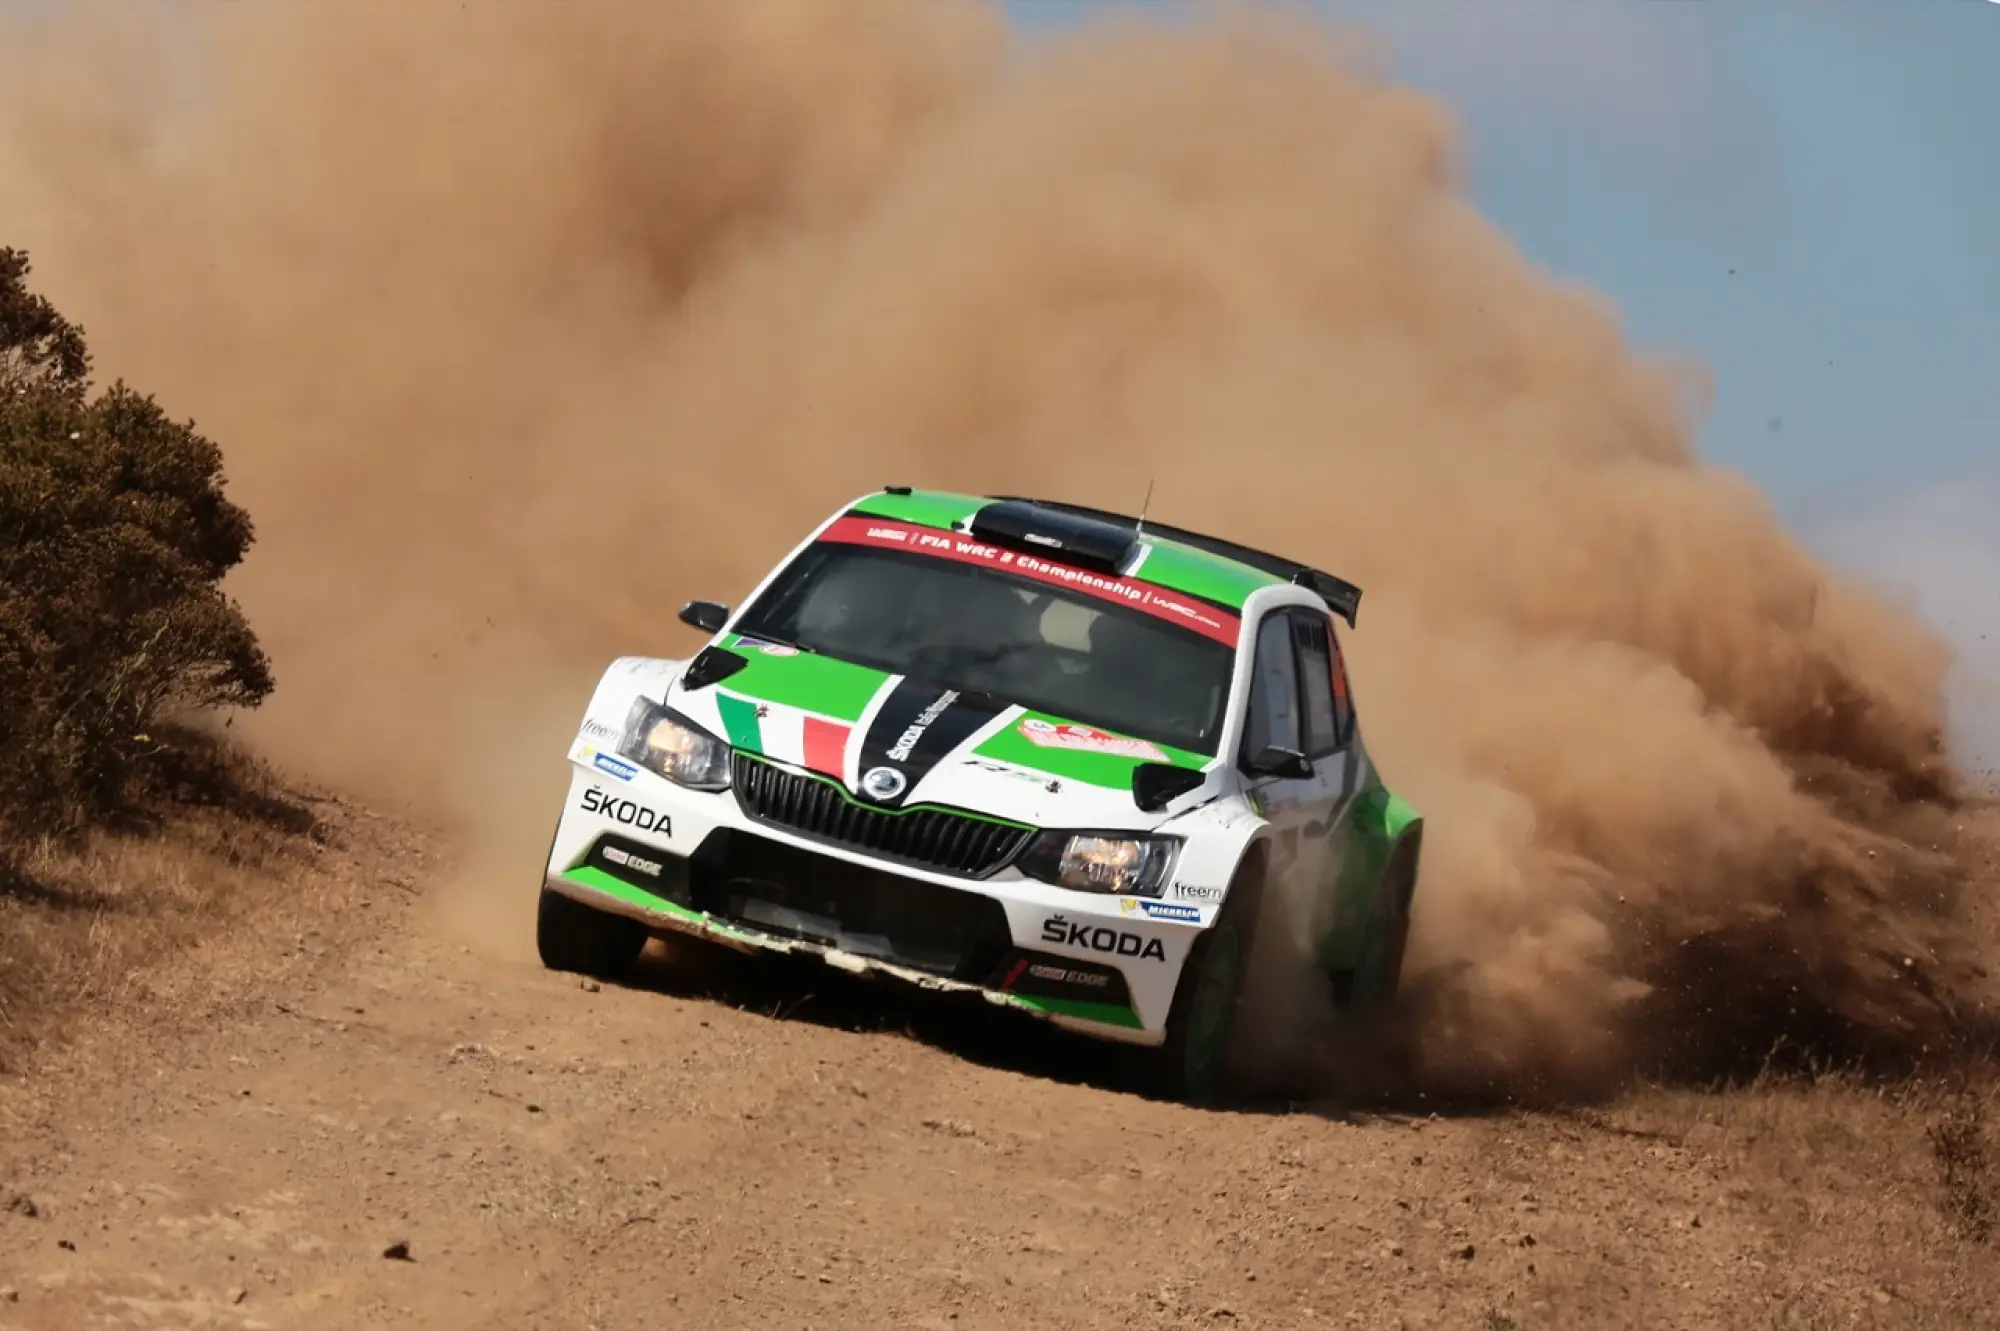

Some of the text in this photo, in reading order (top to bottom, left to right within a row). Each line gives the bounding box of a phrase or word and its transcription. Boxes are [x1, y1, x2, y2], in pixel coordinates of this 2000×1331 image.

[920, 534, 951, 549] FIA
[956, 541, 998, 560] WRC
[1016, 554, 1142, 601] Championship
[580, 784, 673, 838] ŠKODA
[1041, 914, 1166, 962] ŠKODA
[1066, 971, 1110, 987] EDGE
